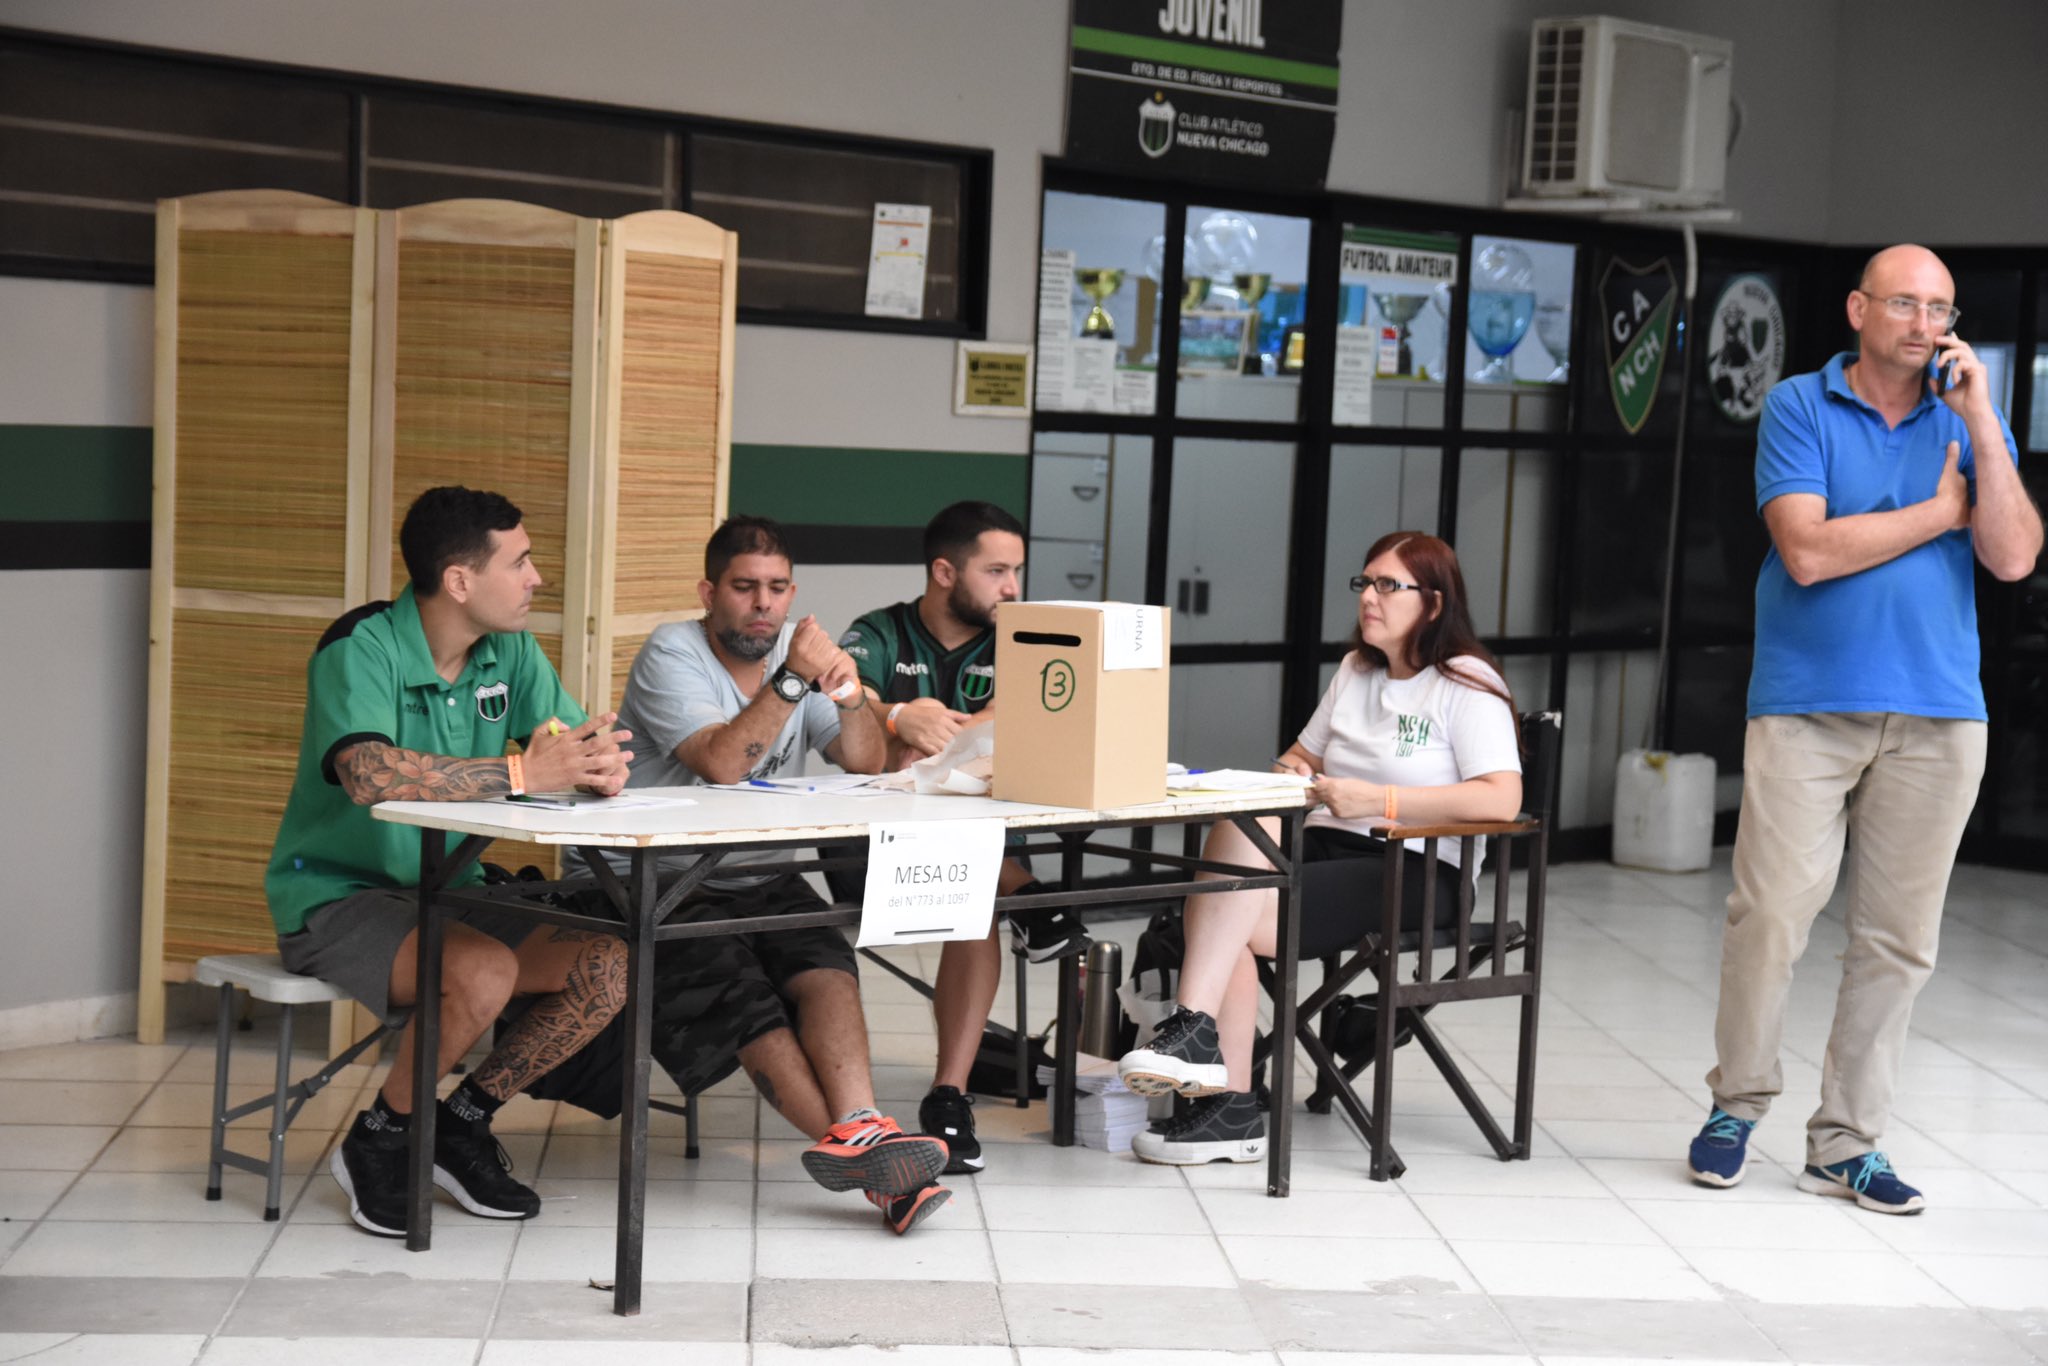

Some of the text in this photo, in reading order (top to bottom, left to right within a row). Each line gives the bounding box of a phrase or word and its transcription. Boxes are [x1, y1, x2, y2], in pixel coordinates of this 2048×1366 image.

[1158, 0, 1265, 49] JUVENIL
[1157, 65, 1172, 79] DE
[1224, 75, 1231, 88] Y
[1232, 78, 1284, 97] DEPORTES
[1178, 112, 1210, 131] CLUB
[1176, 131, 1270, 157] NUEVA CHICAGO
[1341, 249, 1453, 279] FUTBOL AMATEUR
[1617, 330, 1661, 397] NCH
[1134, 608, 1144, 652] URNA
[1048, 671, 1067, 697] 3
[894, 863, 969, 885] MESA 03
[888, 895, 903, 908] del
[936, 892, 945, 905] al
[947, 892, 970, 905] 1097
